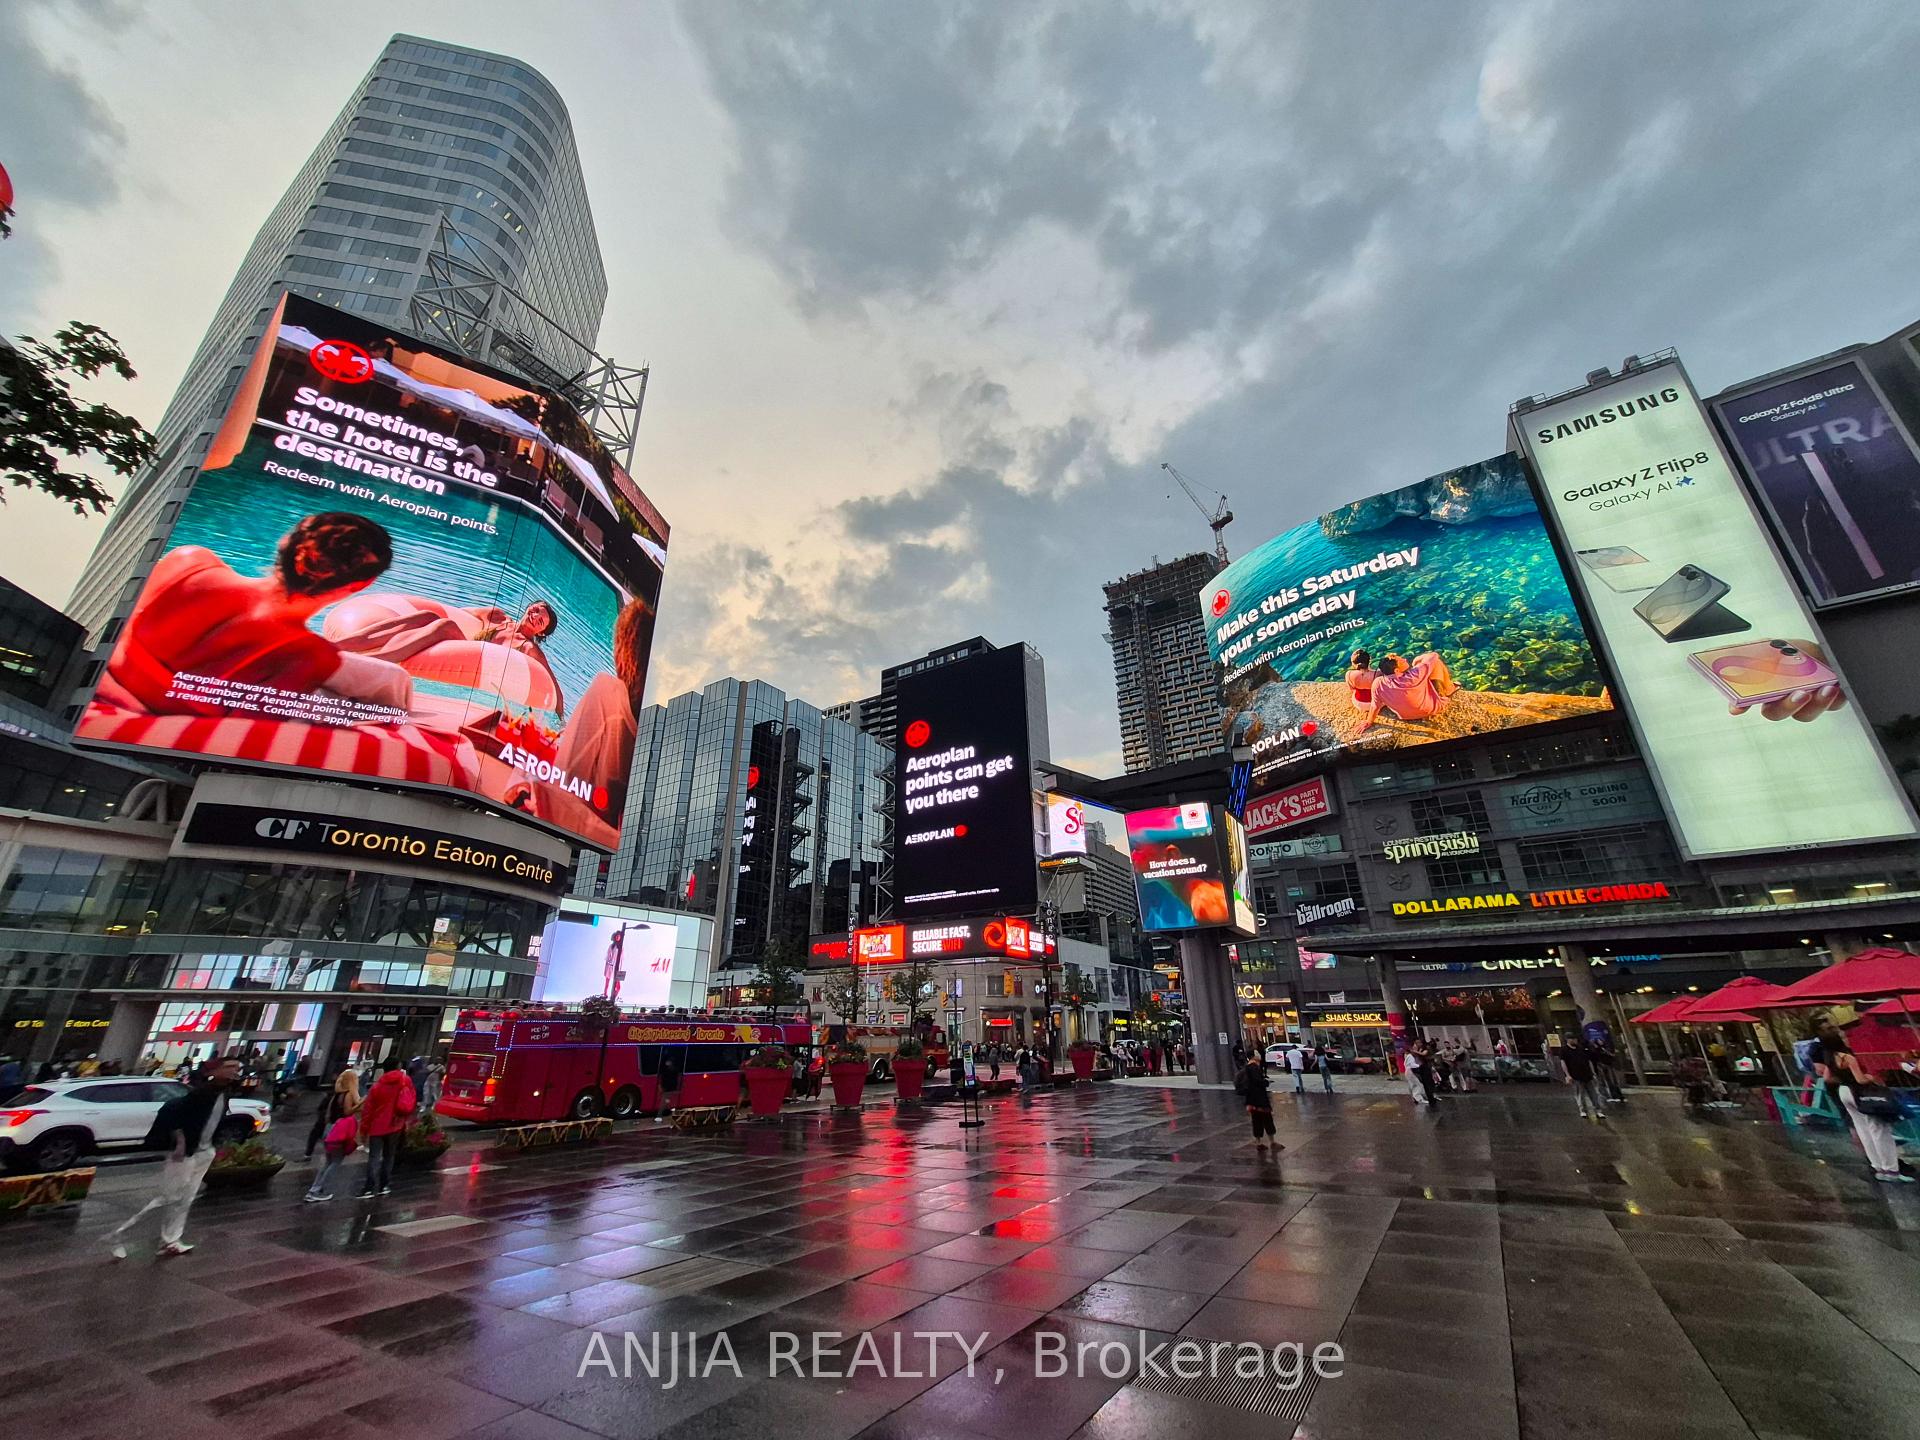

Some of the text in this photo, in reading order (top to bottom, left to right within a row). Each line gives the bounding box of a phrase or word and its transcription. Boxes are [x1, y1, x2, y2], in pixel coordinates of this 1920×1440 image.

[1538, 388, 1679, 444] SAMSUNG
[1739, 405, 1780, 423] Galaxy
[1780, 403, 1790, 411] Z
[1824, 383, 1855, 398] Ultra
[1770, 409, 1806, 423] Galaxy
[294, 387, 464, 457] Sometimes,
[286, 409, 497, 487] the hotel is the
[274, 433, 445, 495] destination
[1564, 451, 1710, 502] Galaxy Z Flip8
[263, 460, 499, 536] Redeem with Aeroplan points.
[1588, 481, 1673, 512] Galaxy AI
[1216, 546, 1419, 645] Make this Saturday
[1219, 590, 1356, 667] your someday
[1223, 616, 1368, 686] Redeem with Aeroplan points.
[171, 680, 408, 726] The number of Aeroplan points required for
[173, 671, 228, 688] Aeroplan
[231, 678, 277, 696] rewards
[279, 688, 298, 699] are
[299, 691, 339, 708] subject
[341, 699, 352, 708] to
[165, 690, 174, 698] a
[176, 692, 221, 705] reward
[223, 698, 260, 713] varies.
[263, 704, 321, 722] Conditions
[499, 742, 592, 801] AEROPLAN
[905, 745, 975, 773] Aeroplan
[905, 755, 1013, 795] points can get
[1580, 783, 1629, 797] COMING
[905, 785, 979, 814] you there
[1300, 788, 1319, 799] PARTY
[1302, 797, 1316, 806] THIS
[1303, 804, 1316, 813] WAY
[1542, 788, 1571, 802] Rock
[1592, 795, 1627, 807] SOON
[255, 817, 553, 884] CF Toronto Eaton Centre
[905, 827, 954, 845] AEROPLAN
[1143, 864, 1208, 880] vacation sound?
[1149, 860, 1167, 870] How
[1168, 857, 1189, 868] does
[1296, 898, 1355, 925] ballroom
[1392, 893, 1520, 915] DOLLARAMA
[912, 925, 970, 942] RELIABLE FAST,
[912, 940, 942, 953] SECURE
[1325, 1013, 1382, 1022] SHAKE SHACK
